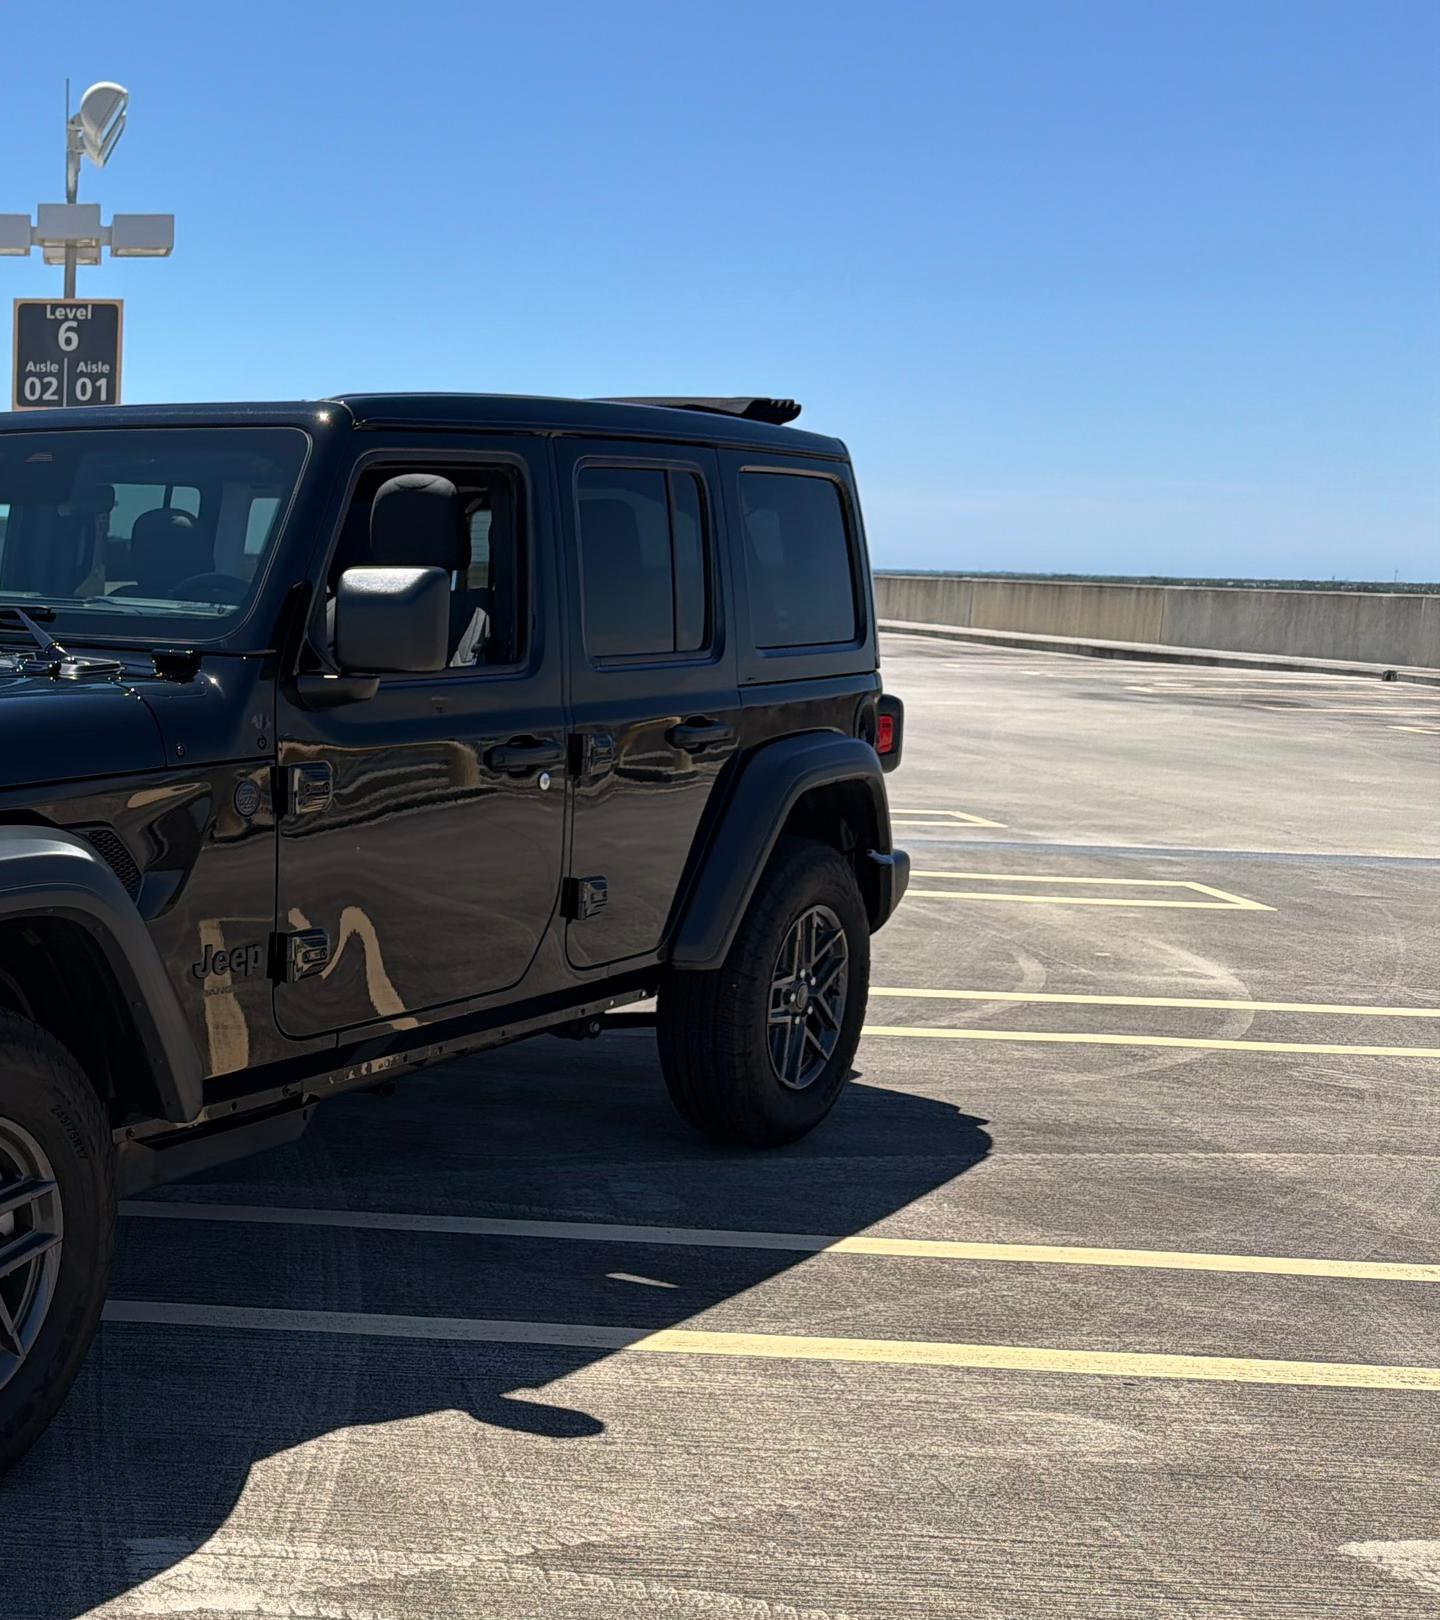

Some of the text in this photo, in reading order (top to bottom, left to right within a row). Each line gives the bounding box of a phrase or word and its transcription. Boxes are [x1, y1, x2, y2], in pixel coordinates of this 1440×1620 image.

[46, 304, 92, 320] Level
[58, 320, 79, 352] 6
[25, 361, 60, 373] Aisle
[76, 361, 110, 374] Aisle
[24, 377, 59, 401] 02
[75, 377, 108, 402] 01
[191, 943, 264, 979] Jeep
